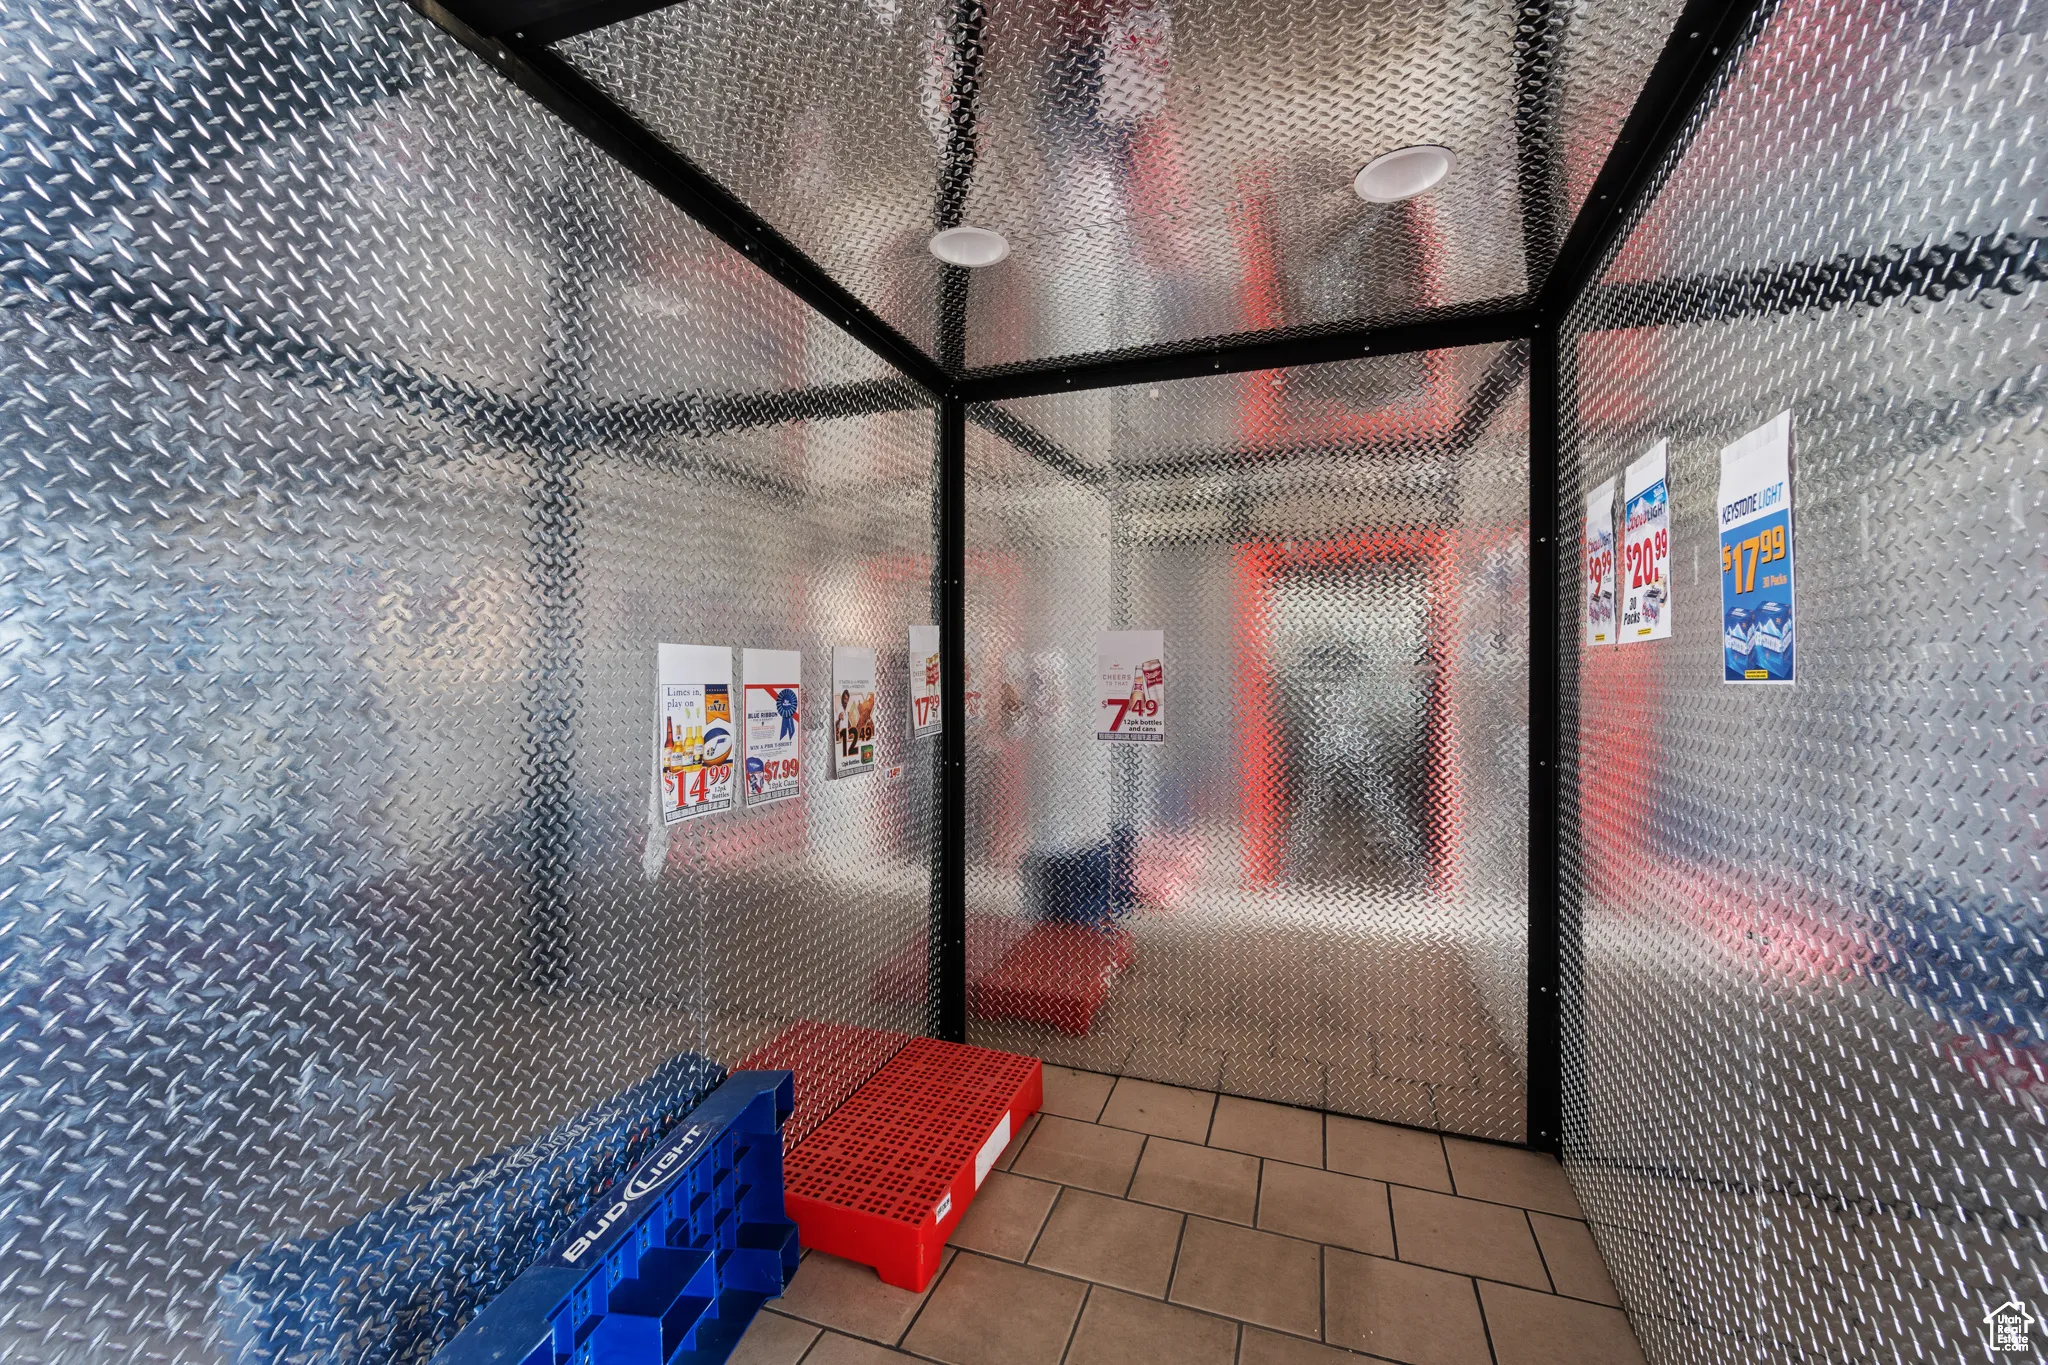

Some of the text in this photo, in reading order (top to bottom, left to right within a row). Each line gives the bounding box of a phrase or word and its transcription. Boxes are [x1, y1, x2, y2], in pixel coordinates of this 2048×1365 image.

[1722, 482, 1783, 525] KEYSTONE LIGHT
[1646, 500, 1666, 521] LIGHT
[1771, 574, 1788, 586] Packs
[1624, 596, 1640, 625] 30 Packs
[667, 687, 702, 697] Limes in,
[667, 699, 682, 711] play
[1123, 719, 1139, 727] 12pk
[764, 758, 799, 785] $7.99
[715, 785, 726, 793] 12pk
[769, 781, 783, 790] 12pk
[712, 792, 729, 800] Bottles
[562, 1125, 701, 1263] BUD LIGHT
